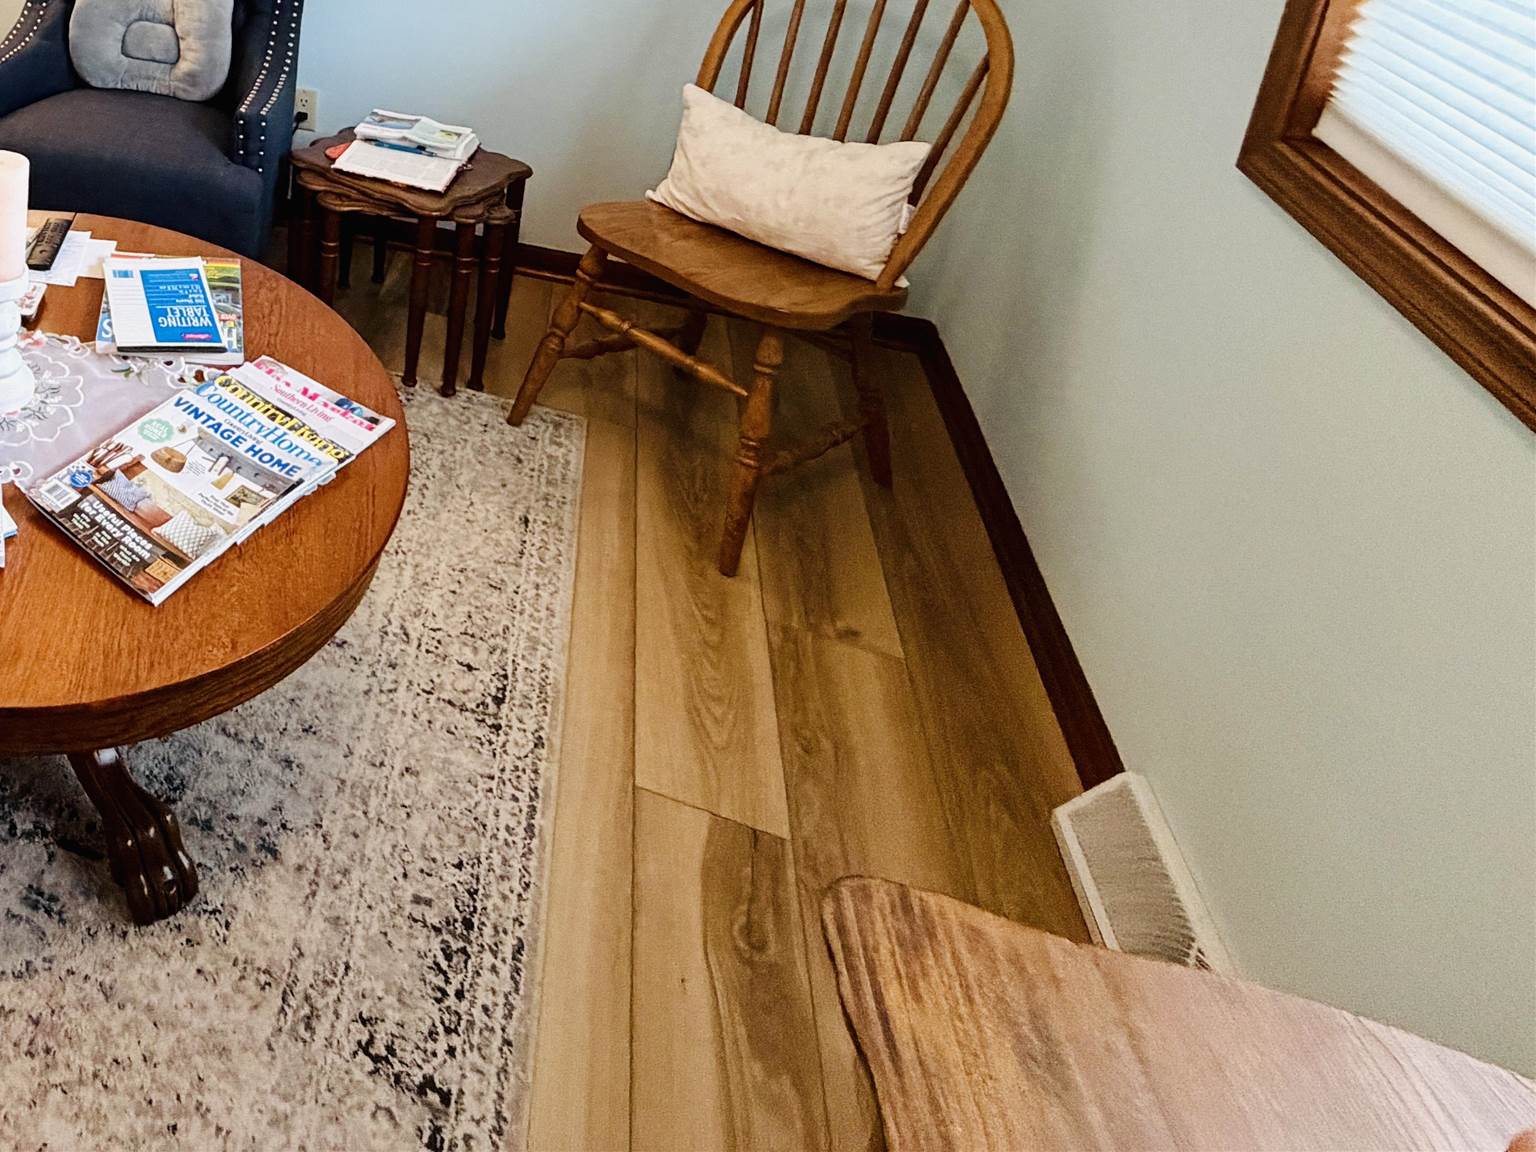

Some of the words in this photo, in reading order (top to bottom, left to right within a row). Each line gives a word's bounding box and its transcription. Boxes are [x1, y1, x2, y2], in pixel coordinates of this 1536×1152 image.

[158, 316, 213, 327] WRITING
[167, 306, 209, 318] TABLET
[174, 396, 247, 448] VINTAGE
[244, 444, 301, 477] HOME
[80, 502, 97, 515] for
[95, 514, 124, 538] Every
[121, 536, 151, 559] Room
[93, 500, 124, 527] Useful
[121, 524, 153, 550] Pieces
